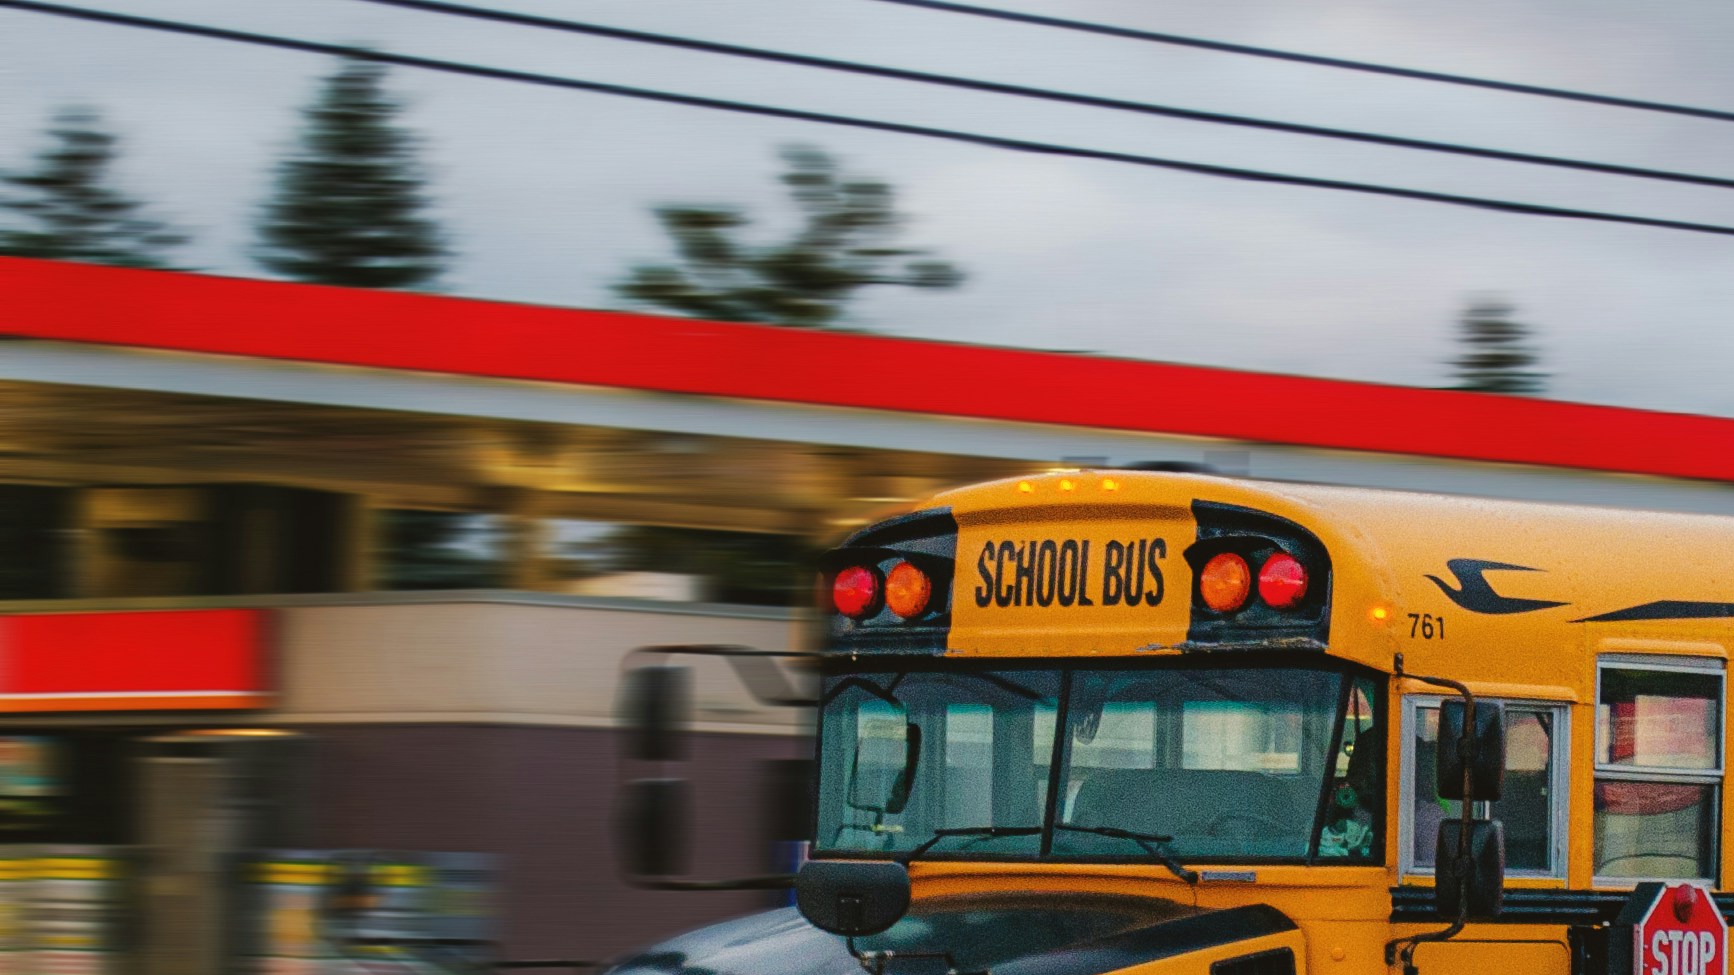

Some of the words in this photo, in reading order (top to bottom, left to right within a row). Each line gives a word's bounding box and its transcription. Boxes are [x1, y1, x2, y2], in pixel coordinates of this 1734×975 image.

[975, 539, 1094, 608] SCHOOL
[1102, 537, 1167, 607] BUS
[1407, 612, 1445, 641] 761
